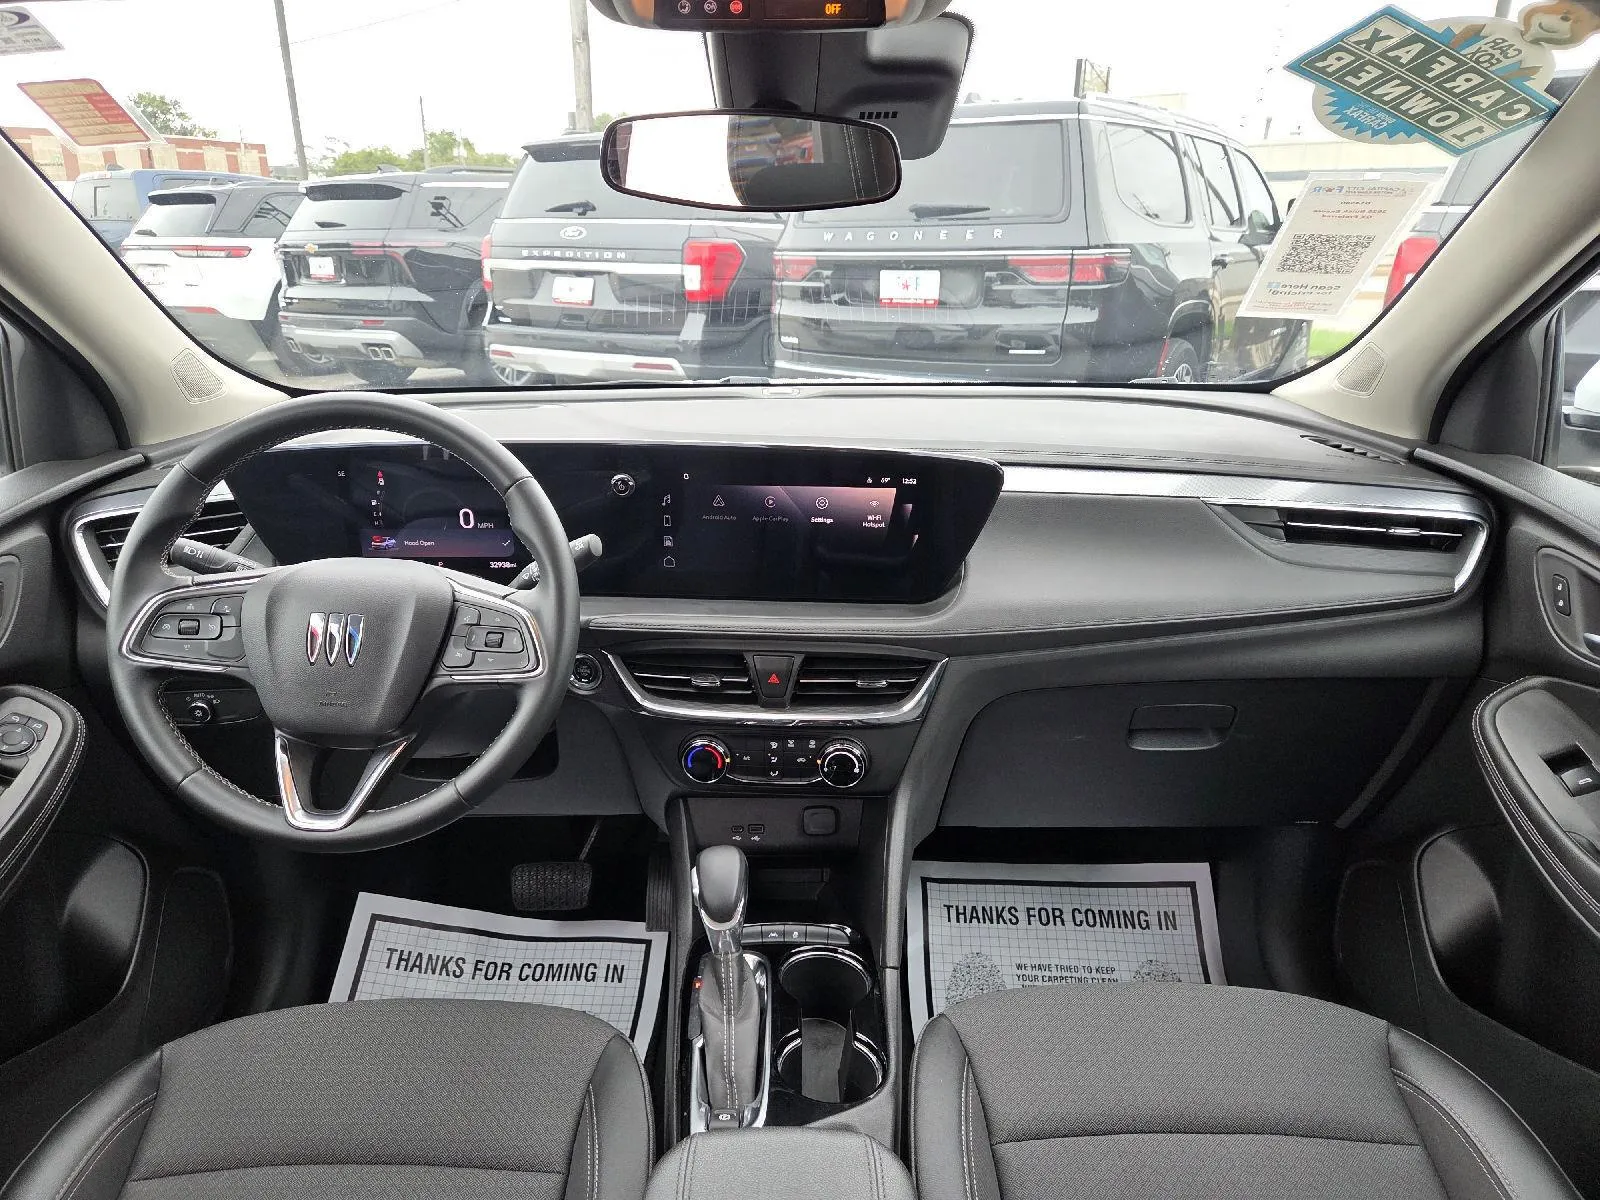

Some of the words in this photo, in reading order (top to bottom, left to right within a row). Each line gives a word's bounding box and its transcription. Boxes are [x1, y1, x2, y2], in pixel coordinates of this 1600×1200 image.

[825, 3, 841, 15] OFF
[823, 228, 1004, 243] WAGONEER
[521, 249, 627, 259] EXPEDITION
[459, 508, 475, 528] 0
[810, 516, 834, 524] Settings
[862, 521, 886, 529] Hotspot
[943, 904, 1019, 926] THANKS
[1026, 907, 1064, 927] FOR
[1071, 908, 1150, 931] COMING
[1157, 910, 1178, 931] IN
[384, 947, 466, 979] THANKS
[471, 959, 513, 981] FOR
[518, 962, 597, 983] COMING
[603, 963, 625, 984] IN
[1015, 963, 1028, 971] WE
[1030, 963, 1052, 972] HAVE
[1055, 964, 1079, 973] TRIED
[1081, 966, 1092, 974] TO
[1095, 966, 1116, 975] KEEP
[1015, 974, 1040, 983] YOUR
[1041, 975, 1089, 984] CARPETING
